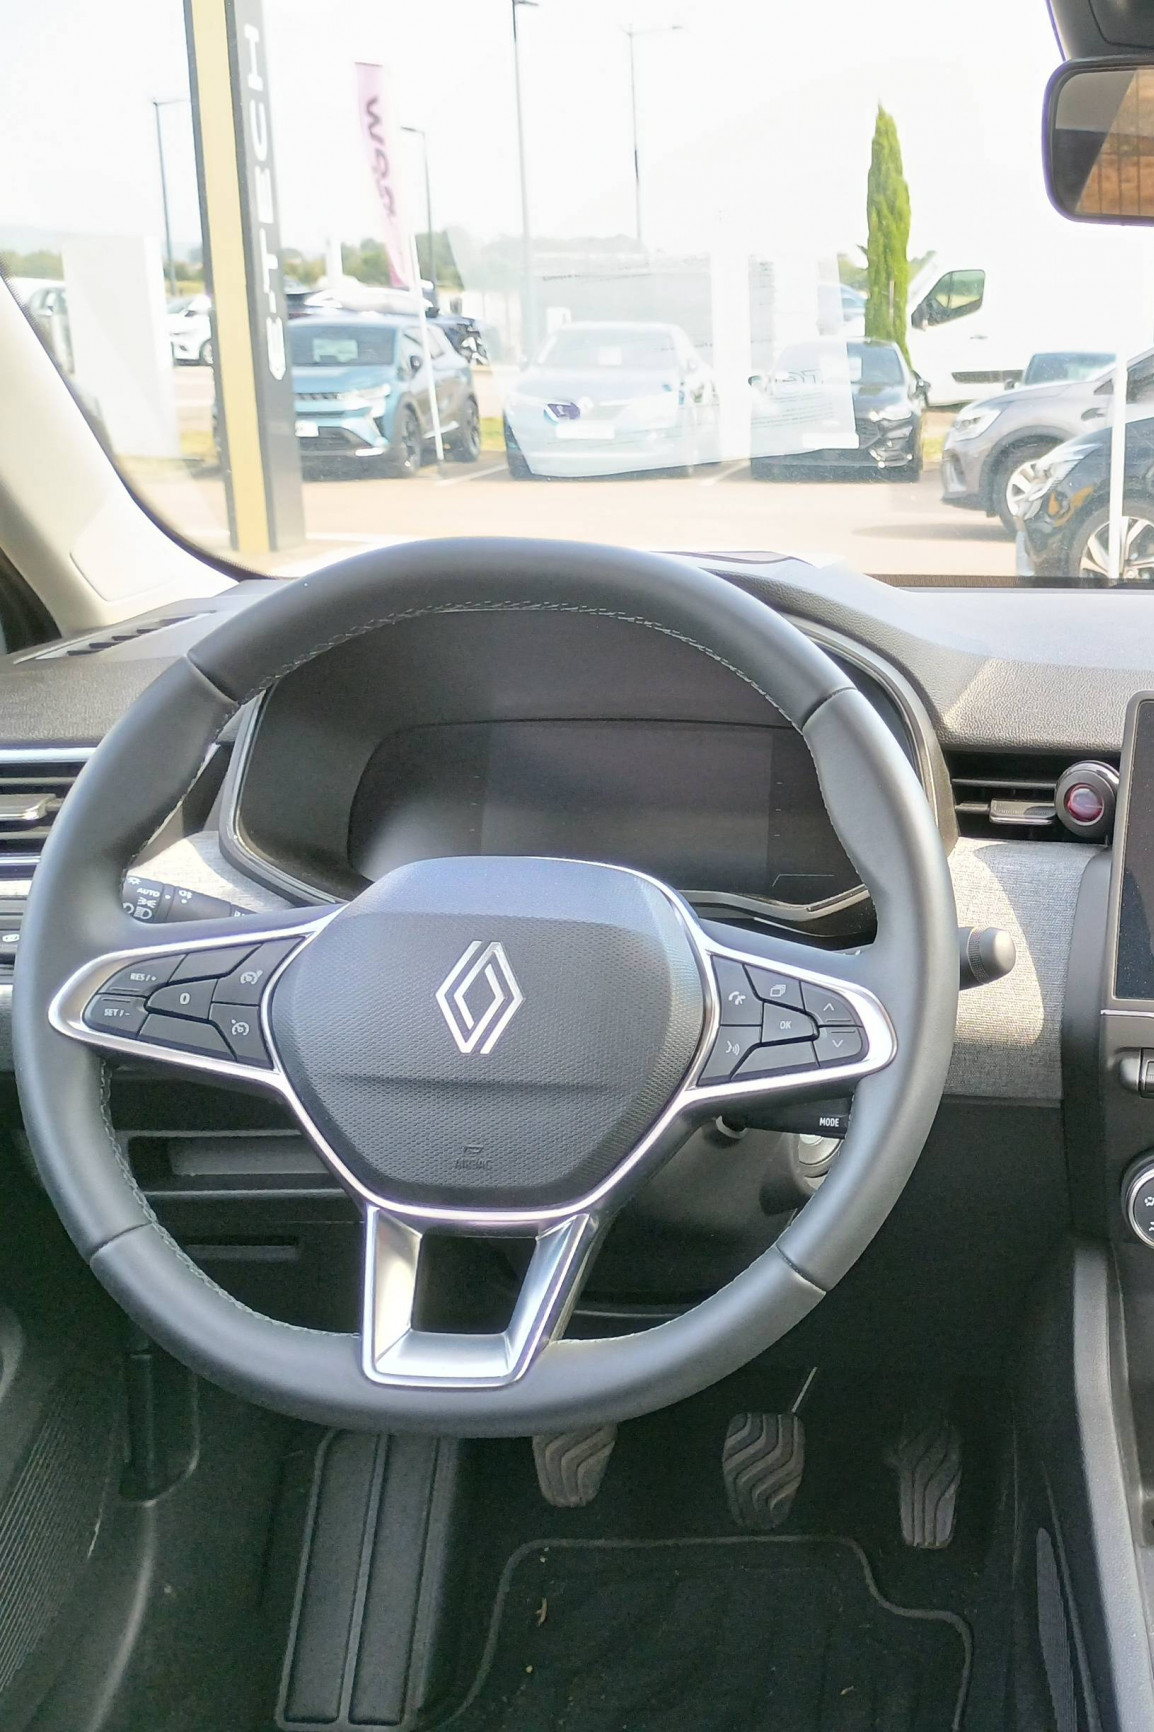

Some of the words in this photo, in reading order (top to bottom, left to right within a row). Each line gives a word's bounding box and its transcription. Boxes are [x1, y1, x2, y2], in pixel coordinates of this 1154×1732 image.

[243, 24, 288, 381] E-TECH
[137, 887, 160, 897] AUTO
[780, 1020, 792, 1030] OK
[819, 1117, 840, 1127] MODE
